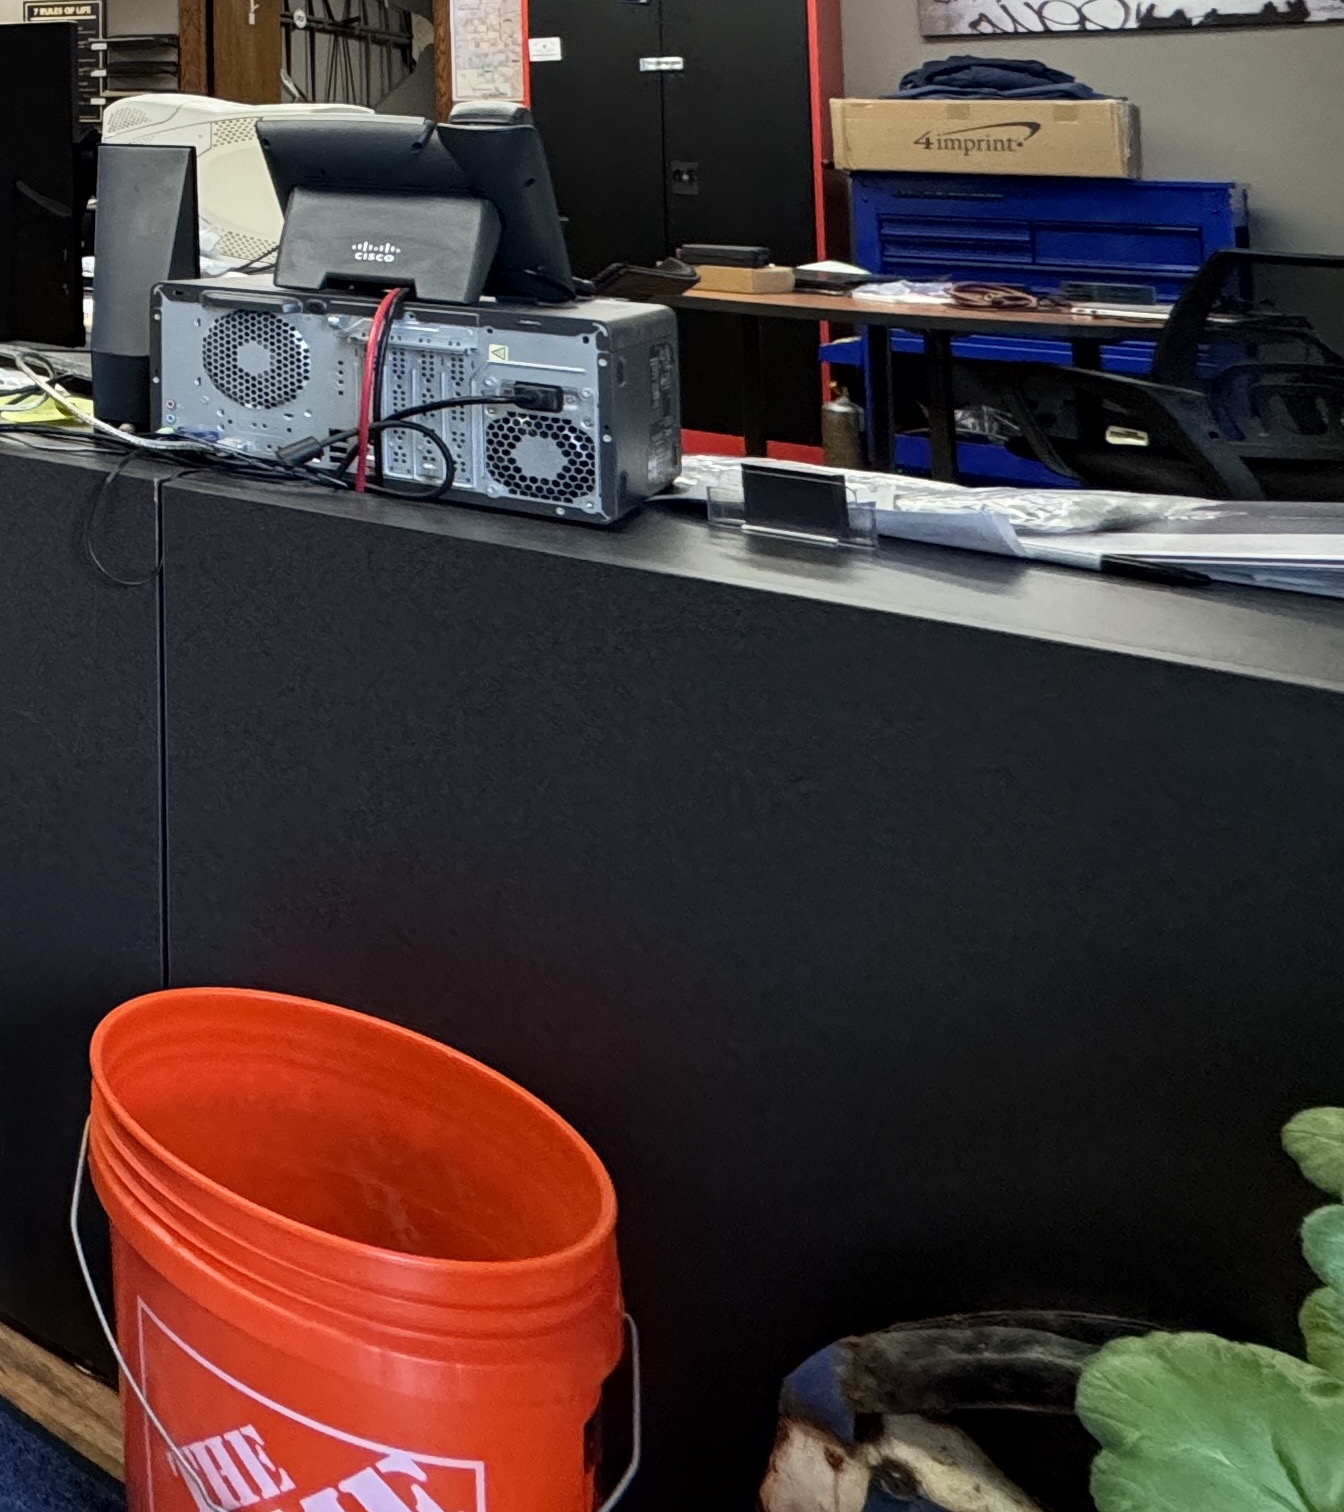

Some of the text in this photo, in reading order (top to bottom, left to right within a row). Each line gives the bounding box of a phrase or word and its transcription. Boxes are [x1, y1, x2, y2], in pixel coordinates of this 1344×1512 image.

[33, 5, 91, 16] 7 RULES OF LIFE
[913, 131, 1018, 156] 4imprint
[166, 1424, 297, 1512] THE
